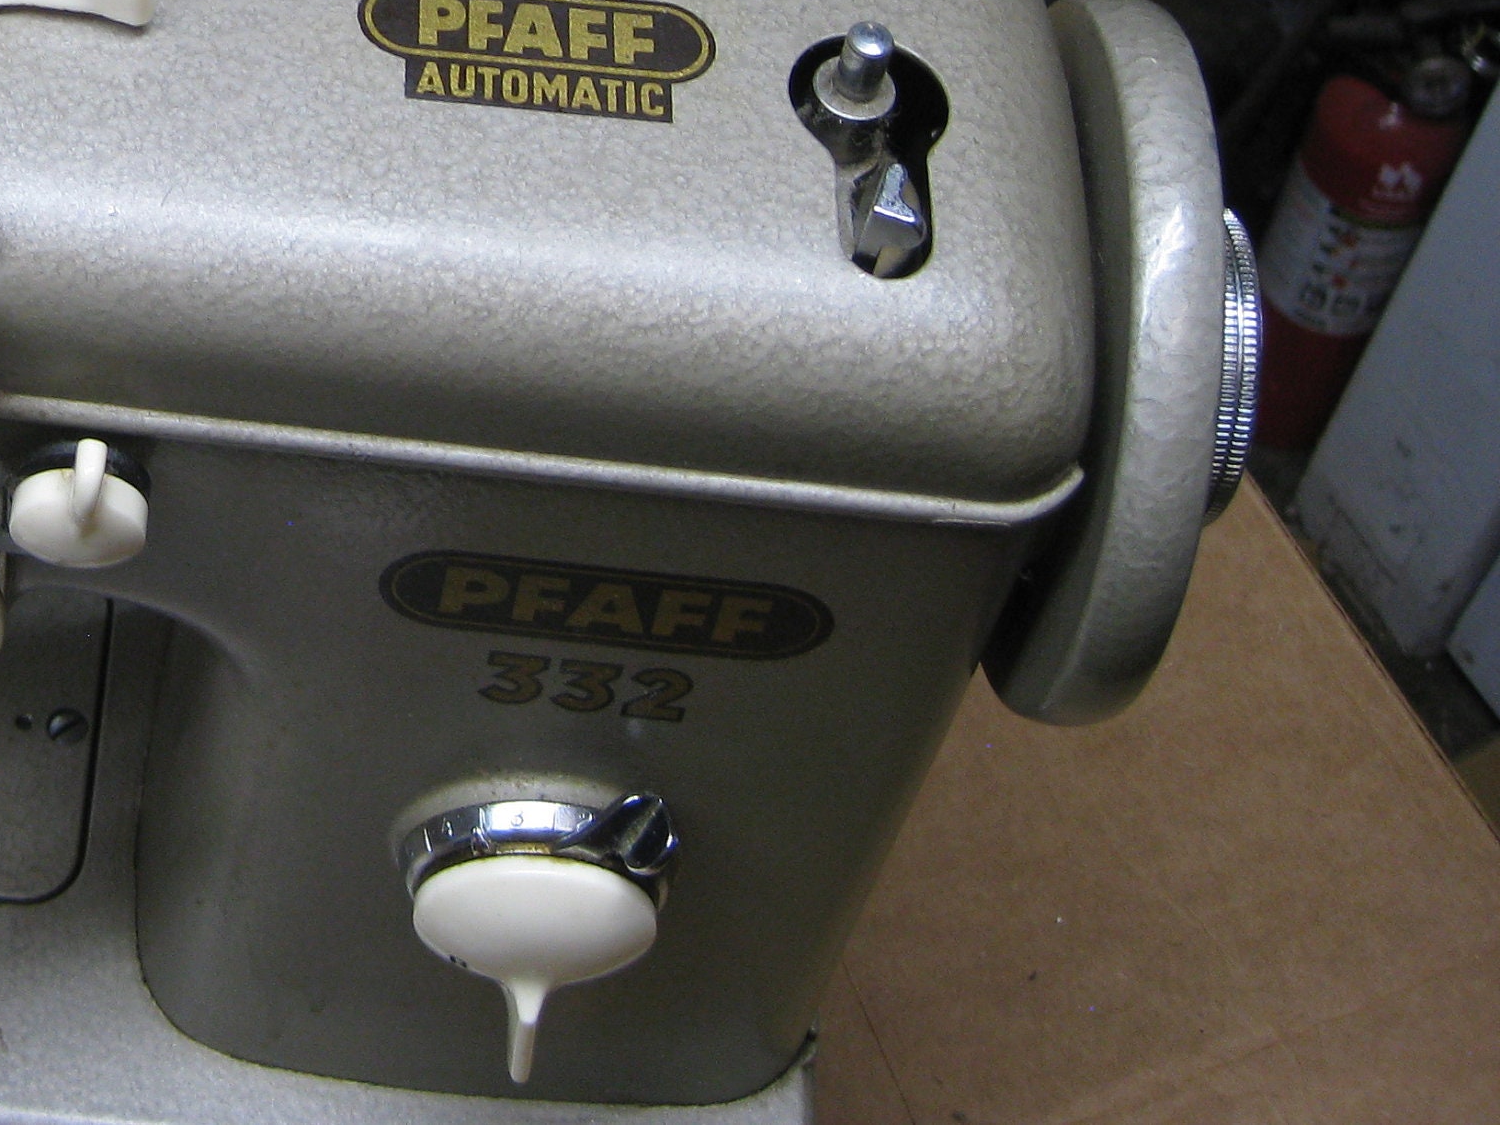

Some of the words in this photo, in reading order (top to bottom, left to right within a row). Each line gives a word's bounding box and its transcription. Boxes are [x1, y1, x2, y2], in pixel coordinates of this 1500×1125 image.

[415, 60, 665, 117] AUTOMATIC
[436, 567, 774, 643] PFAFF
[476, 649, 695, 723] 332
